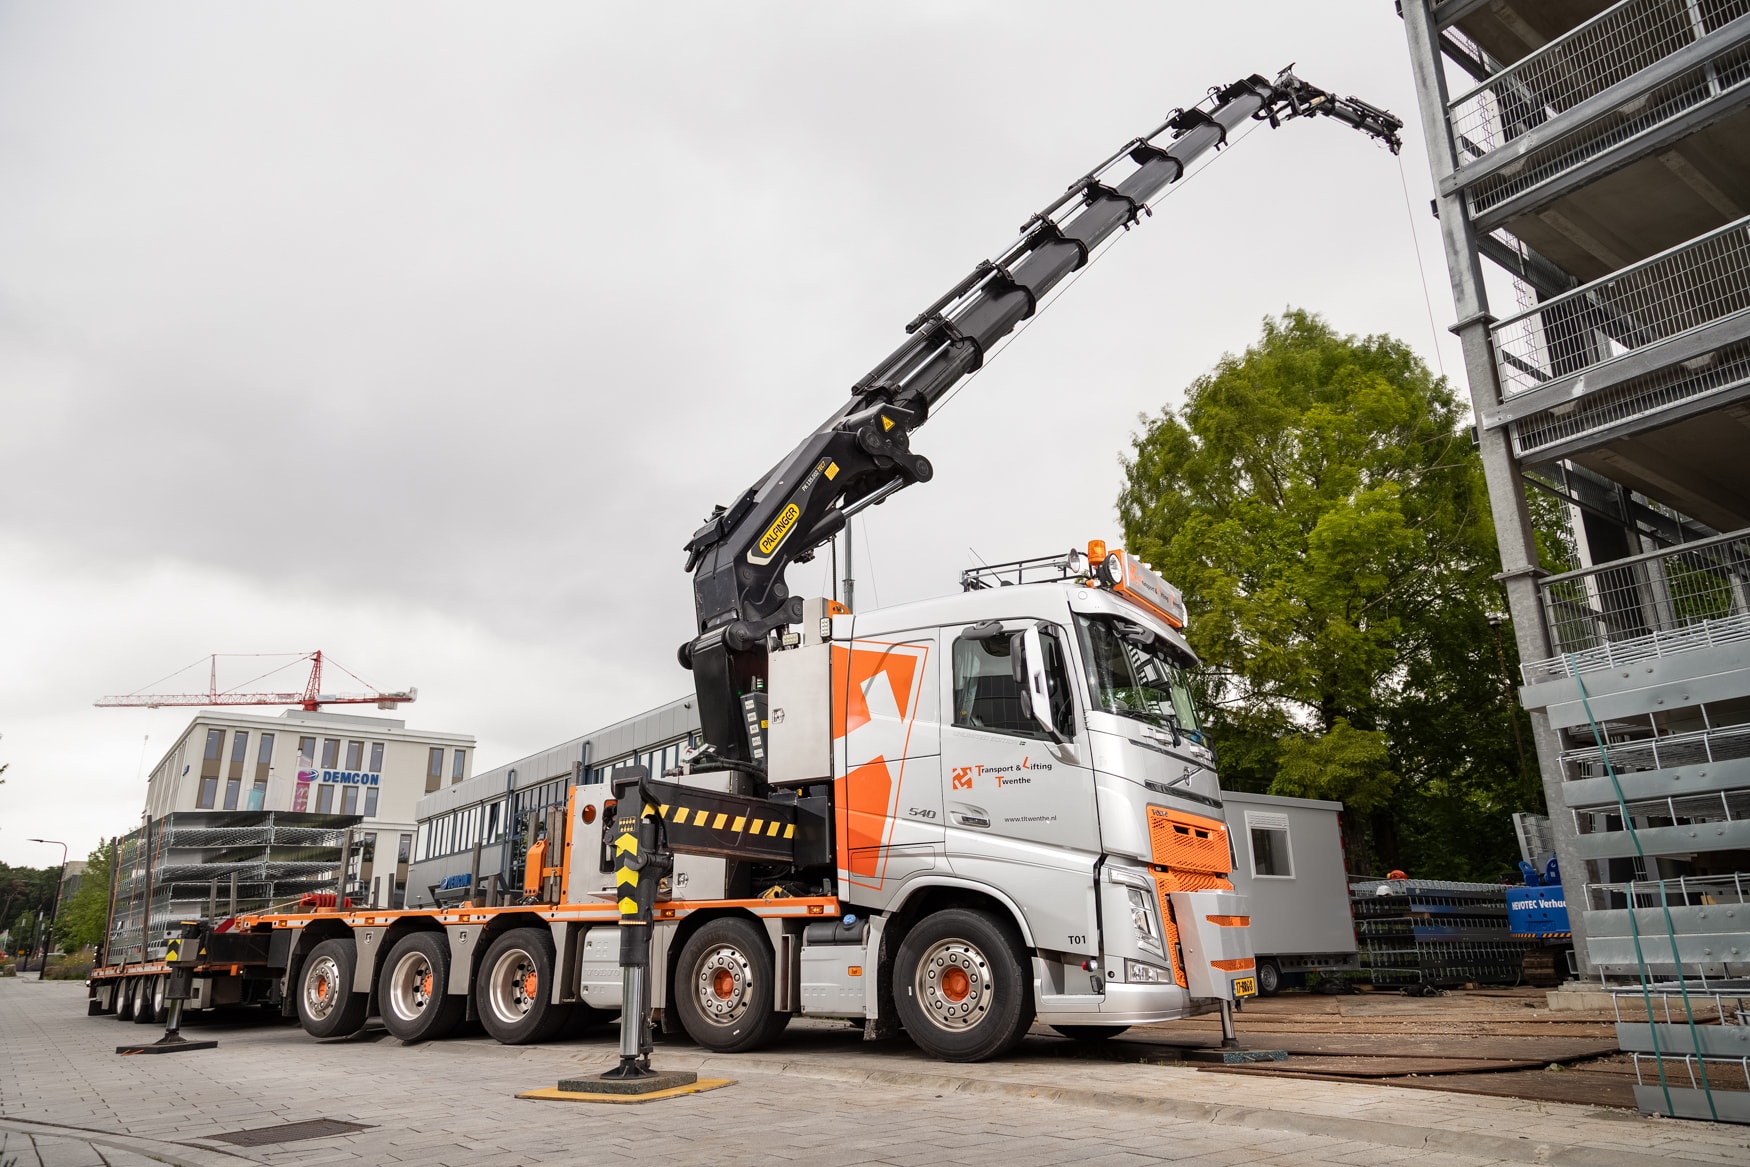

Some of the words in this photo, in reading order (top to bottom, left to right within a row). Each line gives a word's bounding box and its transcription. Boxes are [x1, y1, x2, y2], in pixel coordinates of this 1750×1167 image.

[762, 507, 797, 550] PALFINGER
[975, 765, 1013, 776] Transport
[1022, 756, 1052, 771] Lifting
[323, 770, 380, 785] DEMCON
[995, 776, 1032, 788] Twenthe
[908, 807, 937, 819] 540
[1004, 815, 1057, 823] www.tltwenthe.nl
[1512, 900, 1537, 910] HEVOTEC
[1068, 936, 1086, 944] T01
